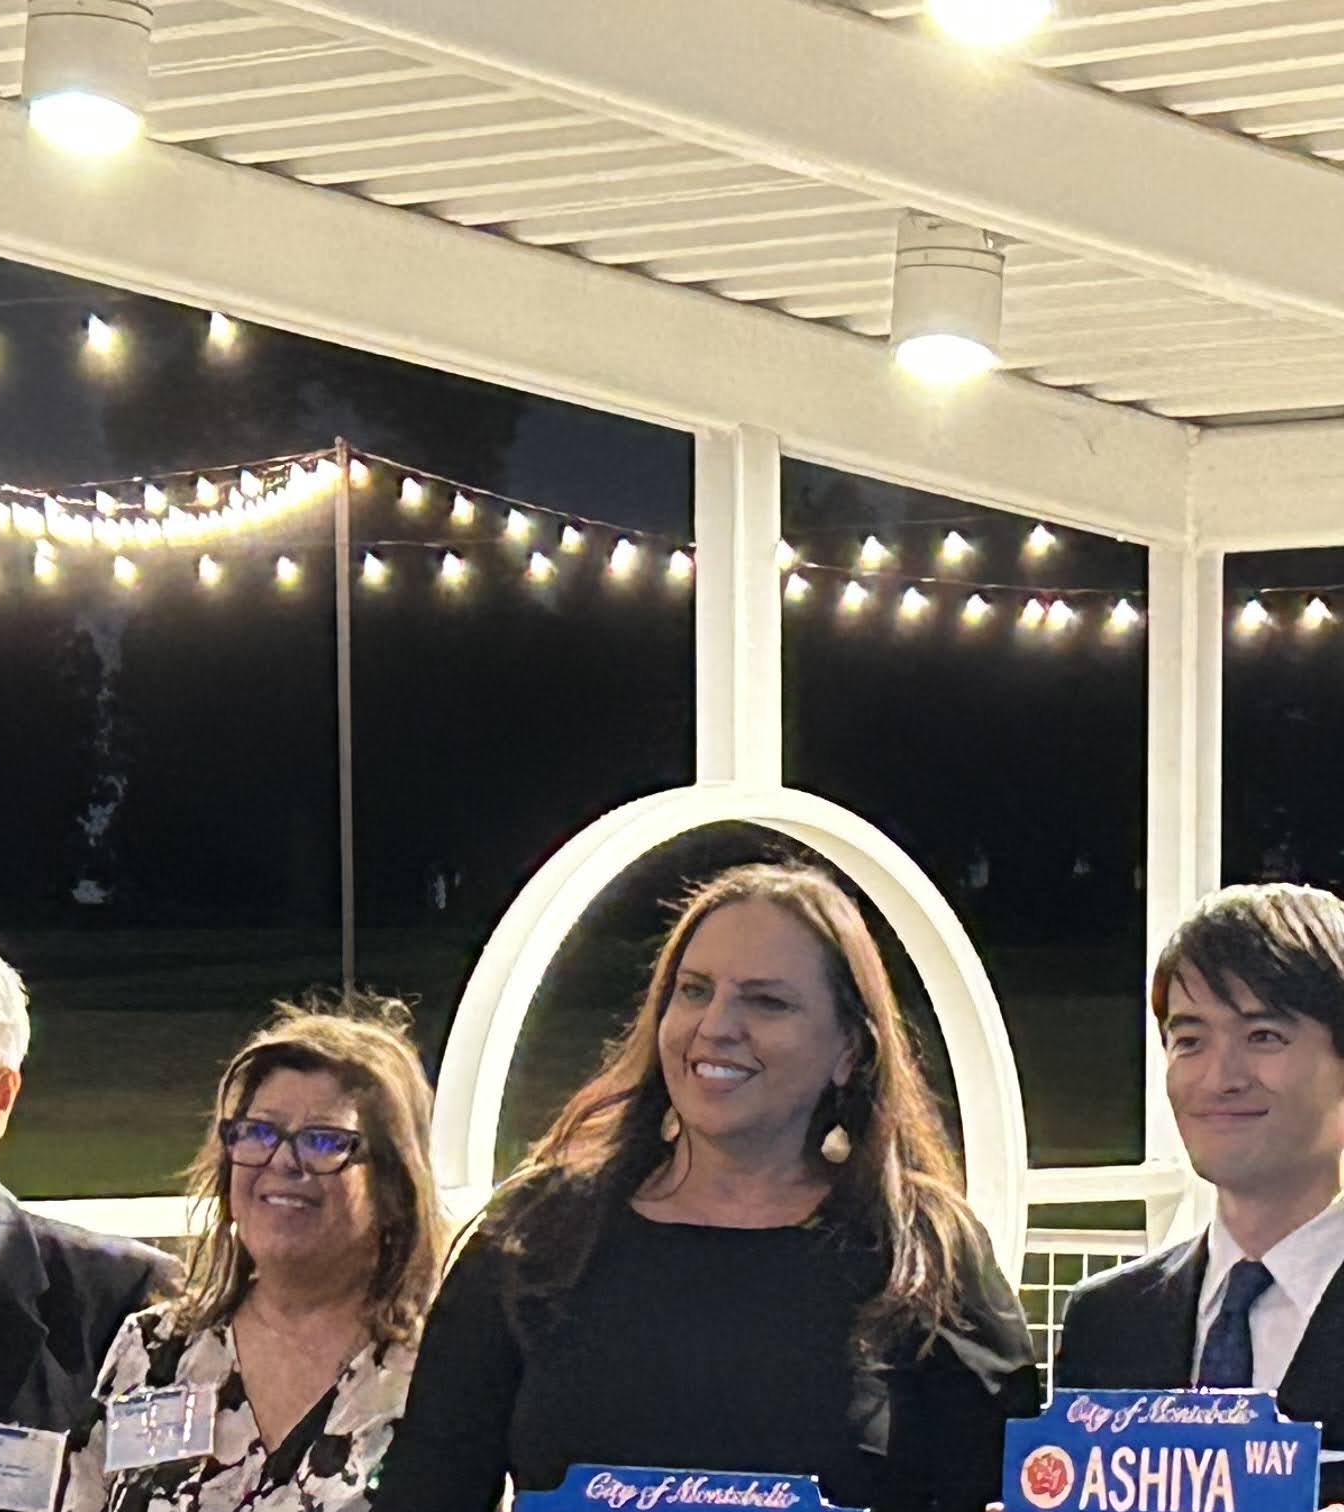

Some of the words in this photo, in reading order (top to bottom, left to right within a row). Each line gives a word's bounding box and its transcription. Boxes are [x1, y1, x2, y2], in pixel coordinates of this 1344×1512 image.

[1066, 1394, 1113, 1433] City
[1110, 1396, 1148, 1433] of
[1244, 1439, 1299, 1475] WAY
[585, 1472, 637, 1509] City
[636, 1476, 676, 1510] of
